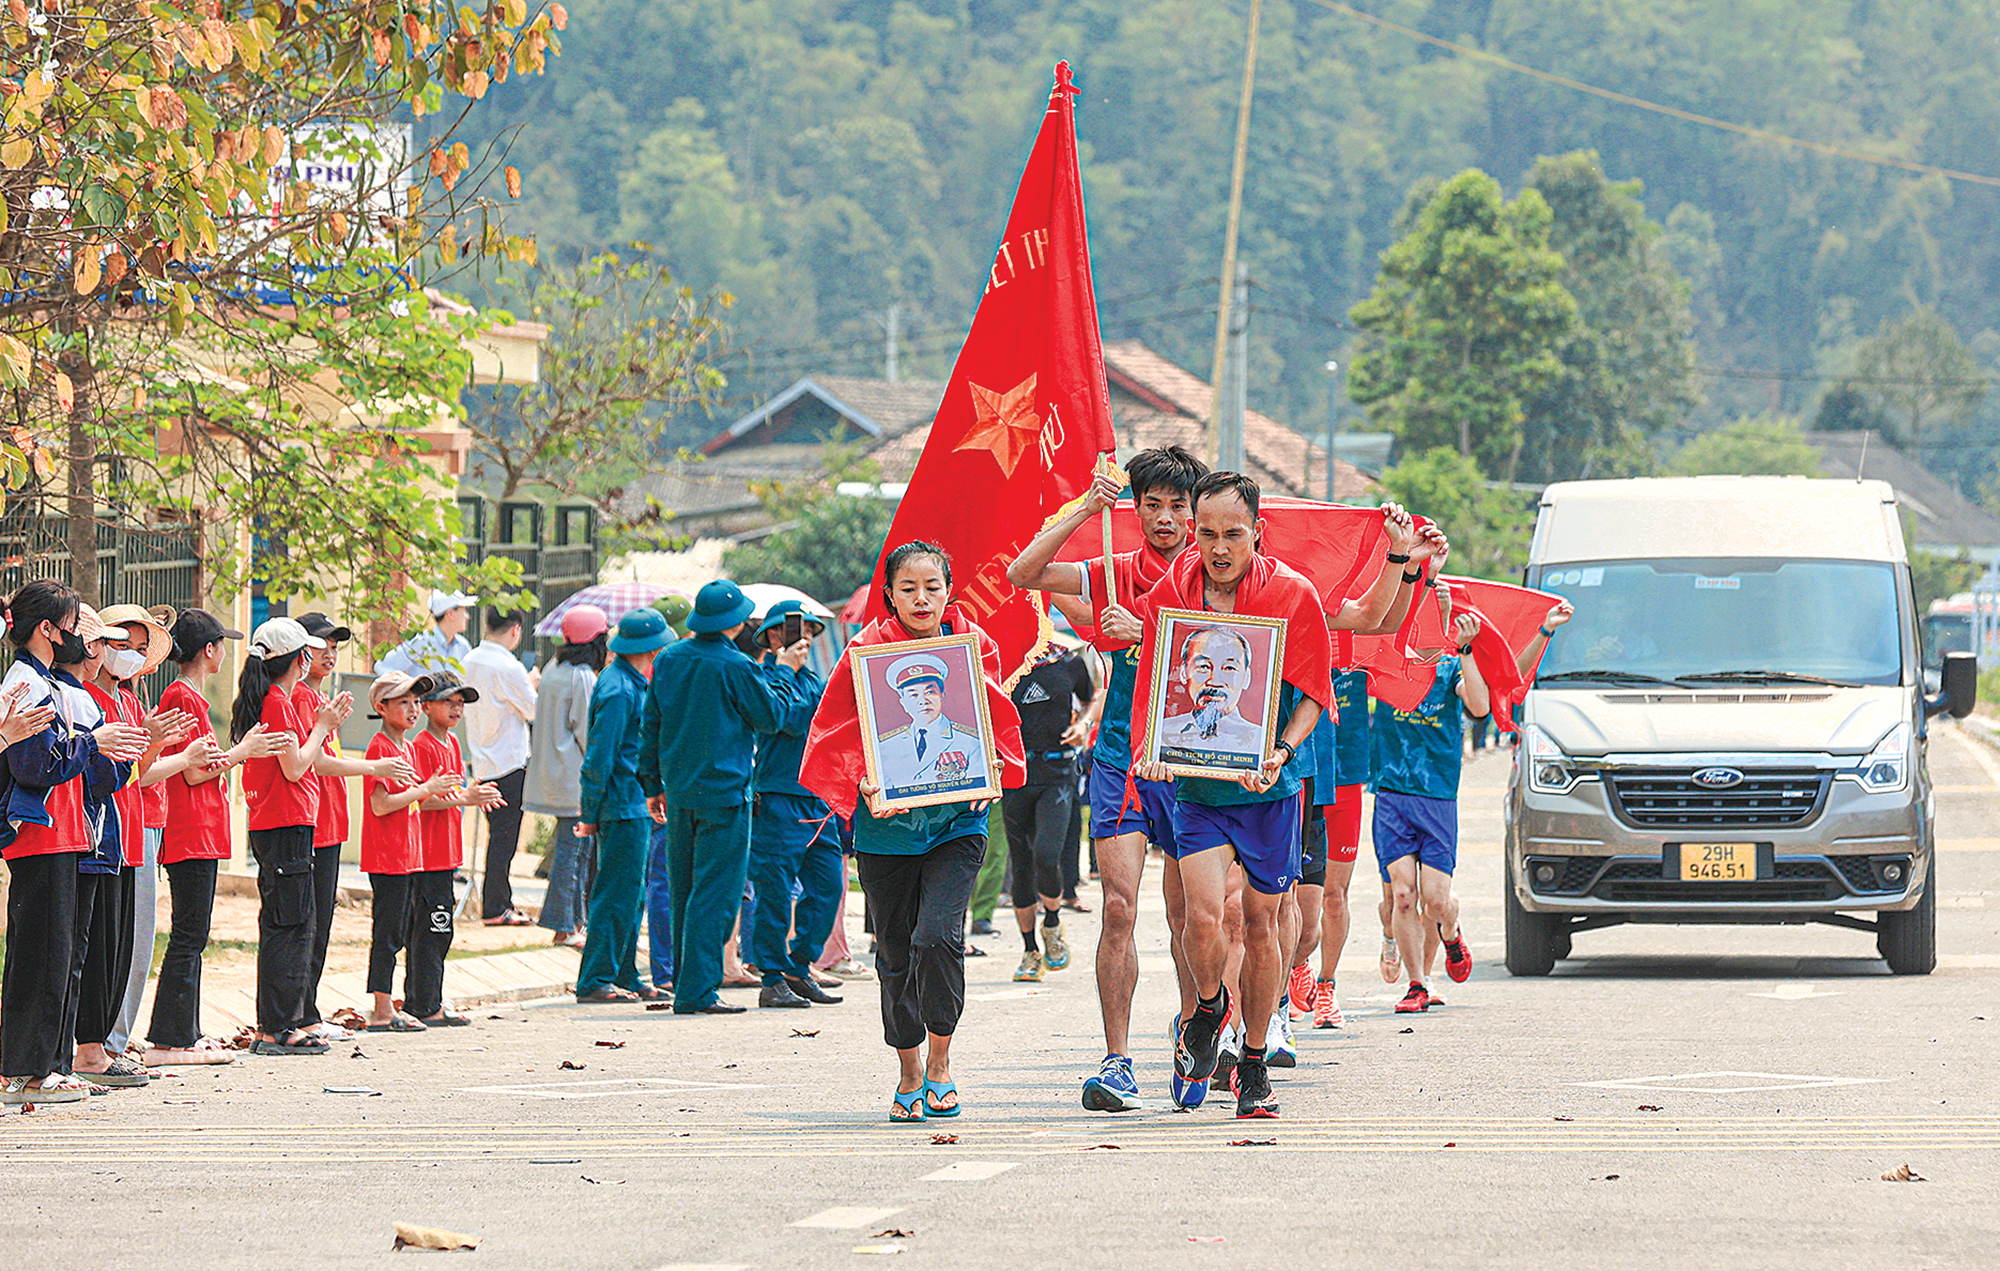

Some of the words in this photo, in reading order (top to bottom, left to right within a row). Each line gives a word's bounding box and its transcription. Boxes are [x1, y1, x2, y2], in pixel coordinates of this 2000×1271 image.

[1702, 770, 1731, 784] Ford
[1703, 846, 1734, 861] 29H
[1690, 864, 1745, 878] 946.51
